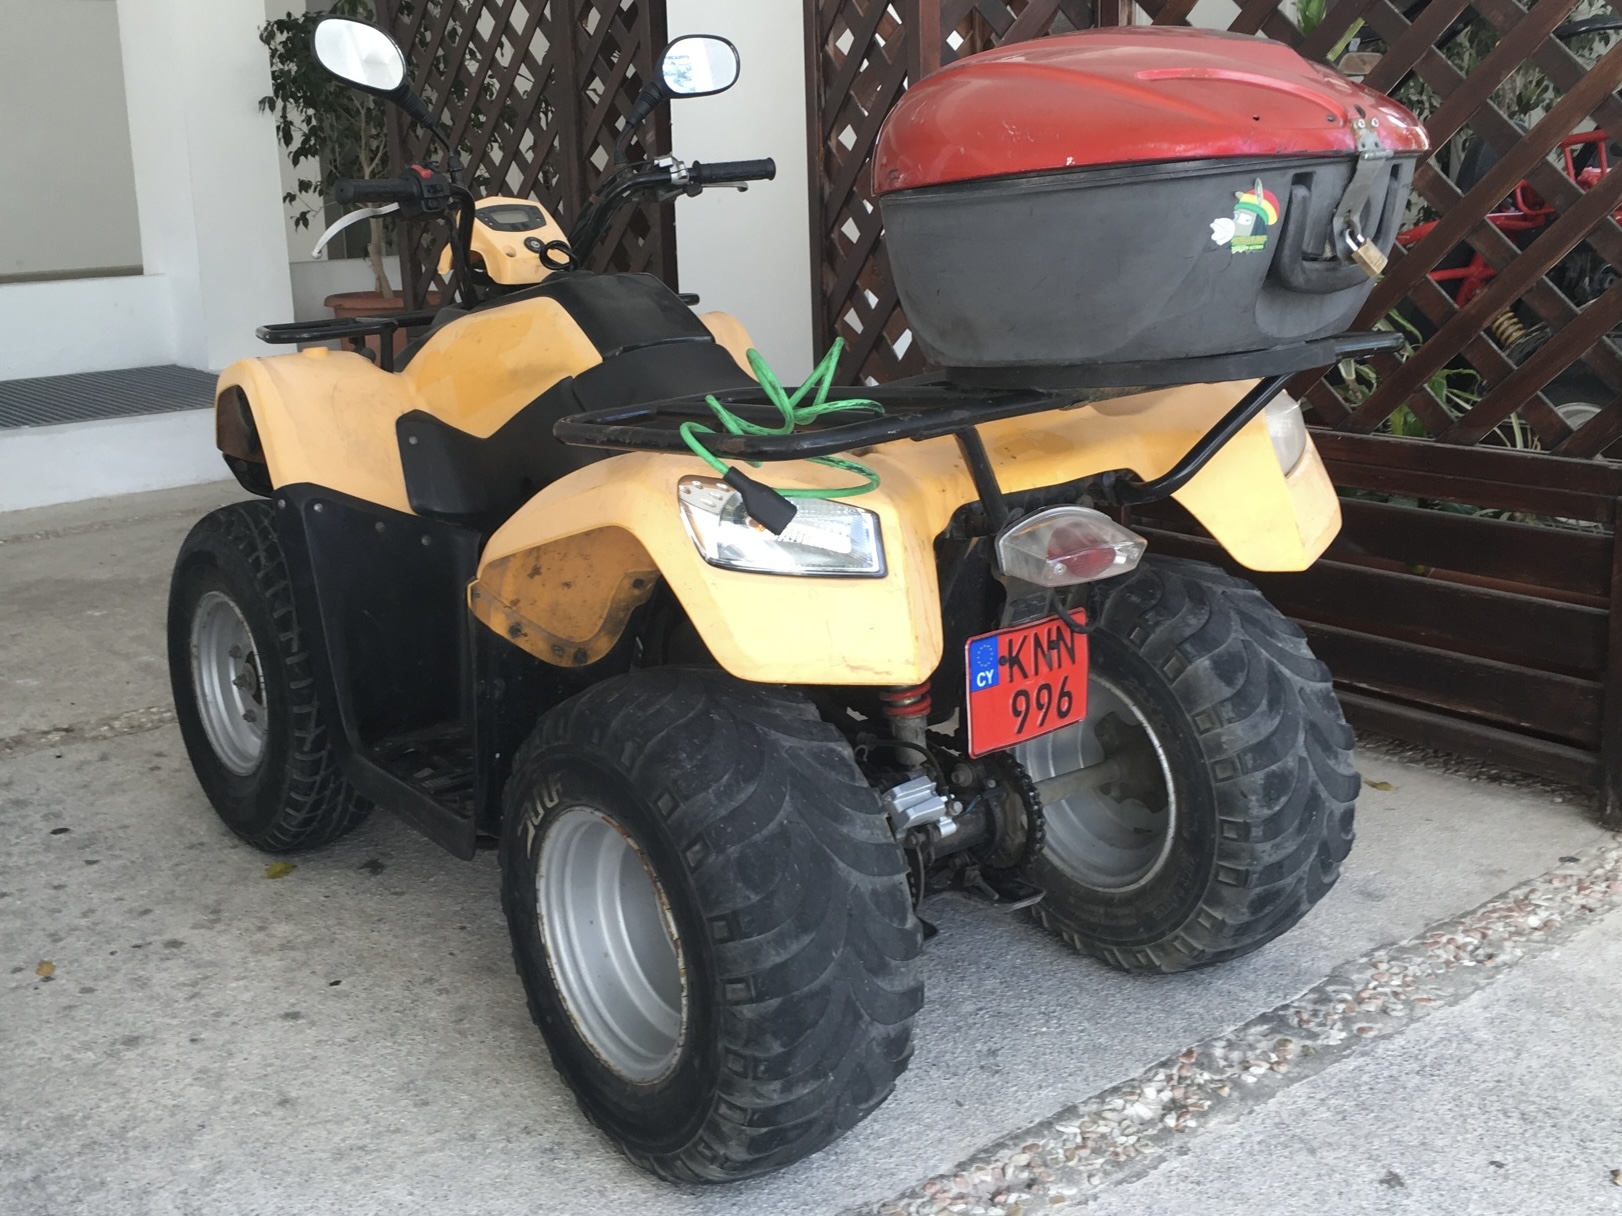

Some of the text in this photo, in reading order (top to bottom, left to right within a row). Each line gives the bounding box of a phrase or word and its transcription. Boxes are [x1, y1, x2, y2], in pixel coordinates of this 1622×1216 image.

[976, 669, 995, 688] CY
[1008, 625, 1076, 683] KNN
[1011, 675, 1073, 734] 996
